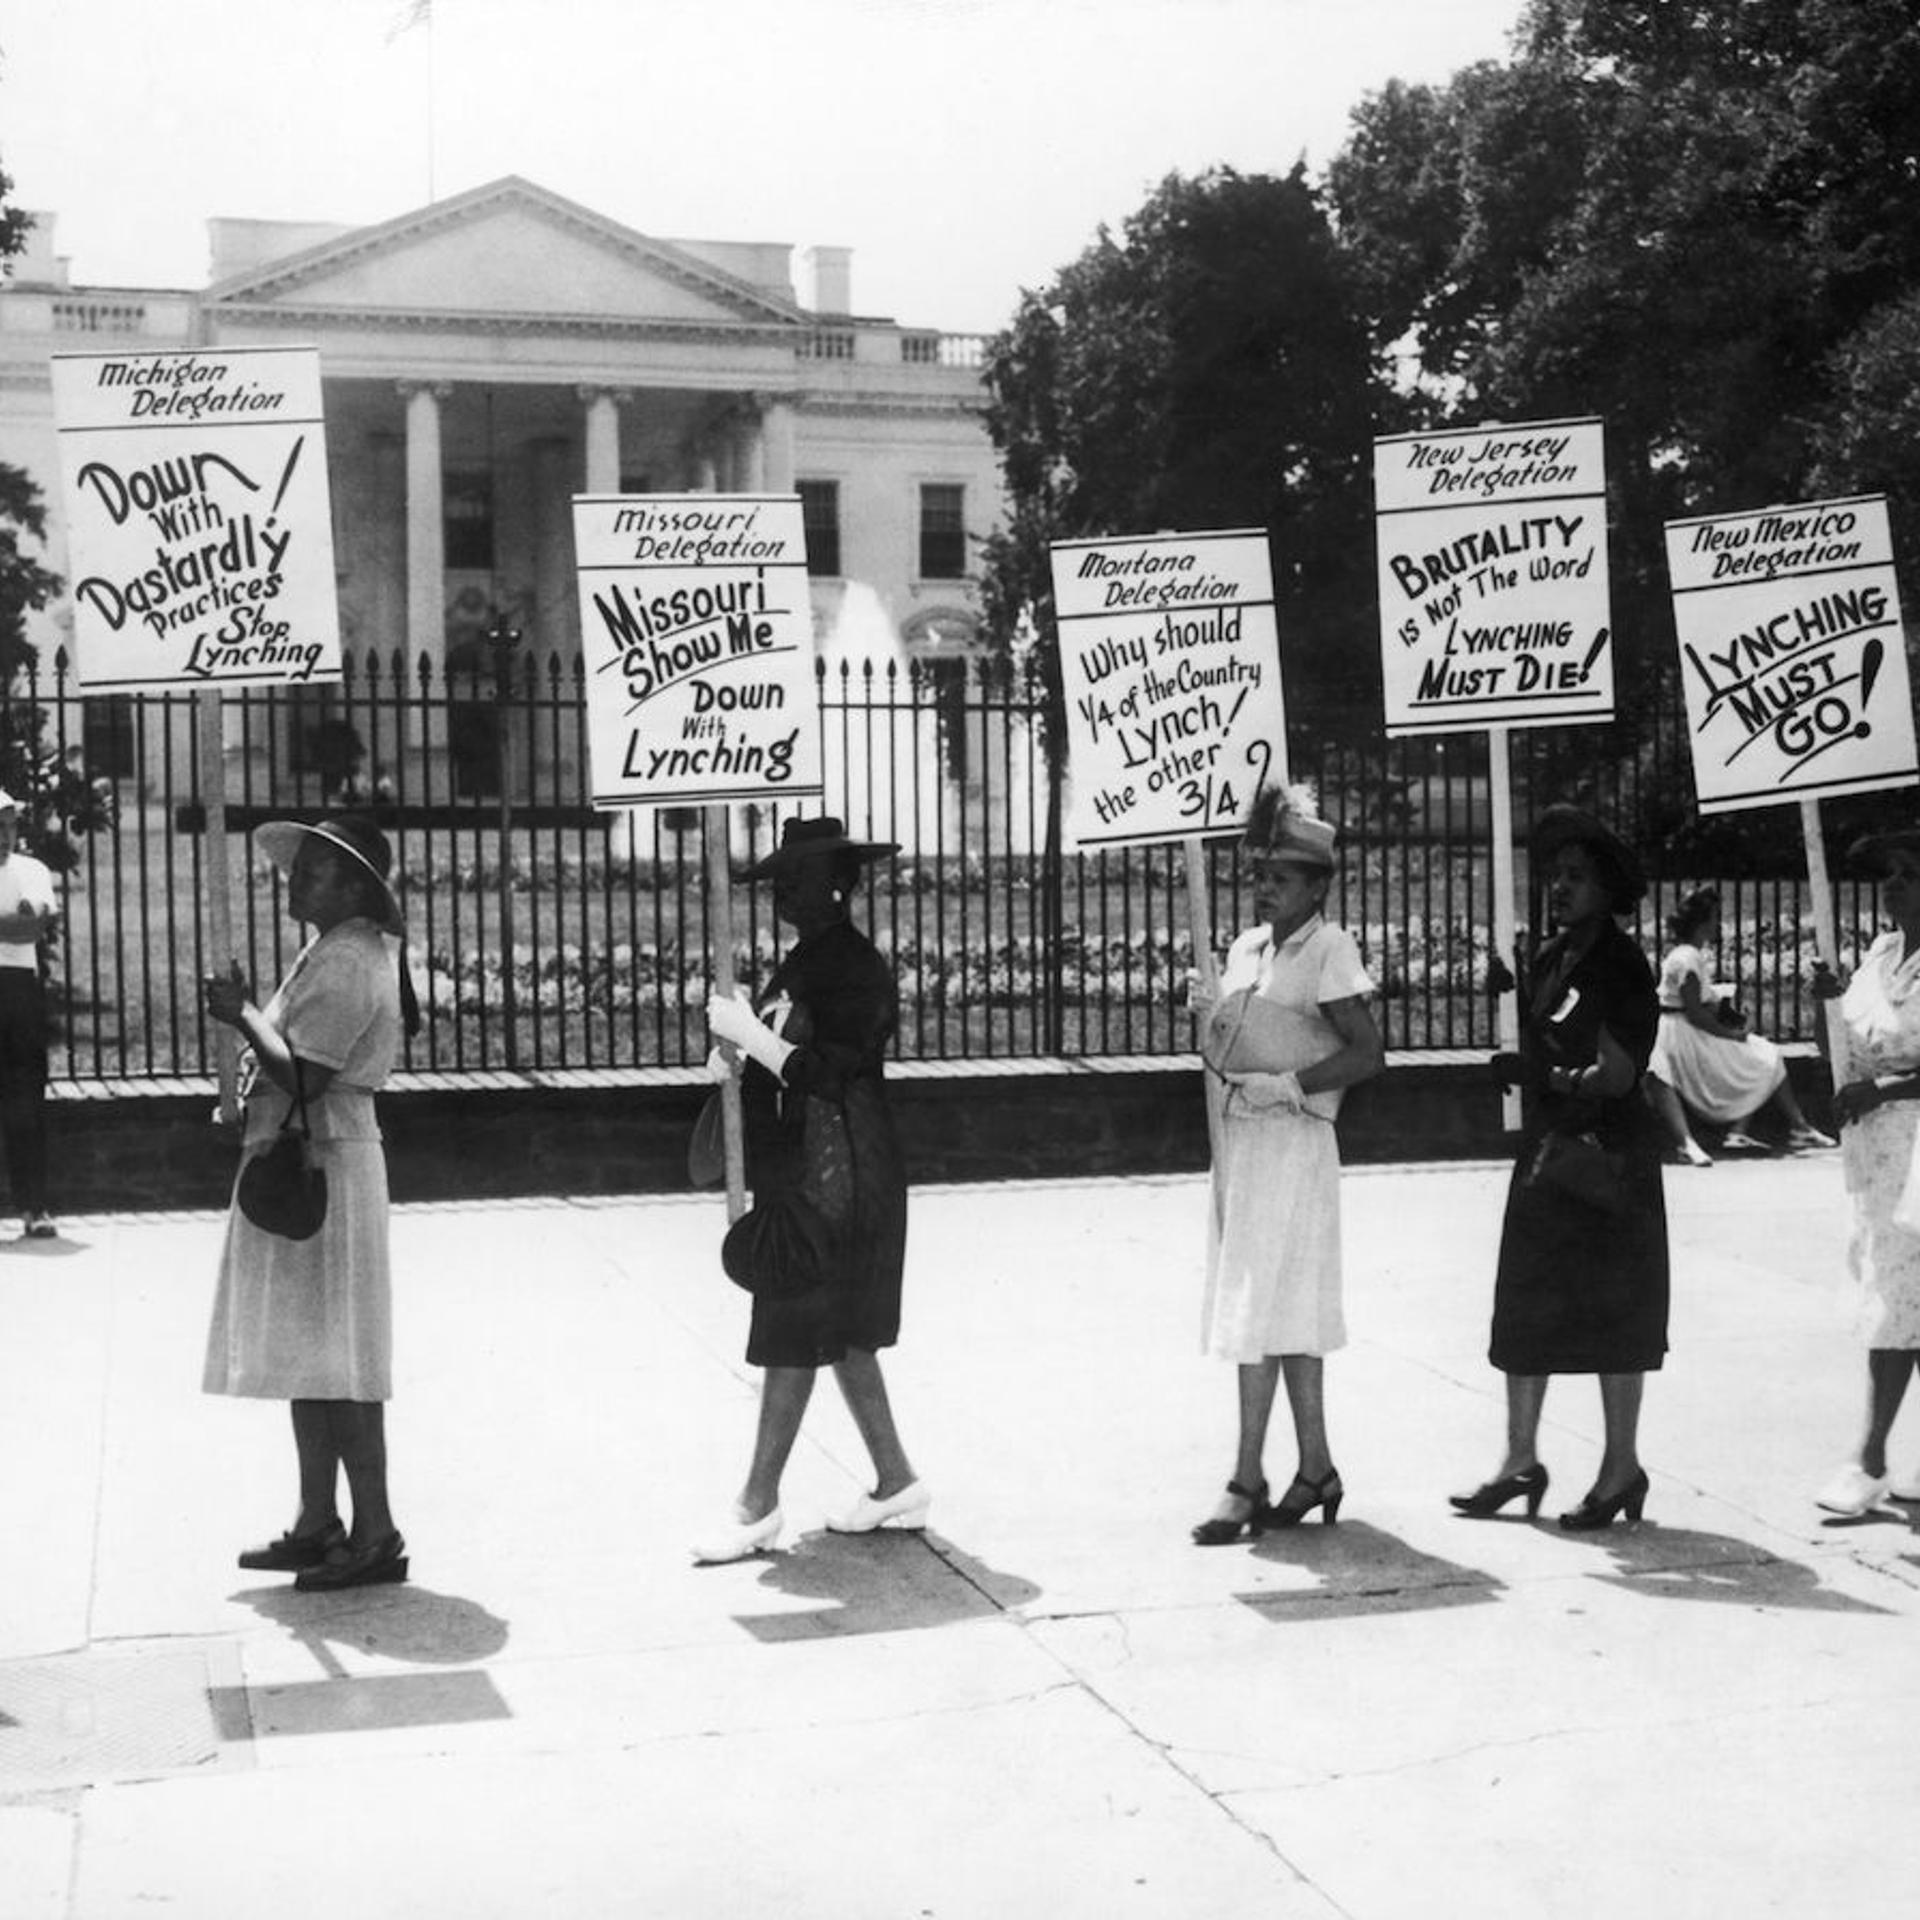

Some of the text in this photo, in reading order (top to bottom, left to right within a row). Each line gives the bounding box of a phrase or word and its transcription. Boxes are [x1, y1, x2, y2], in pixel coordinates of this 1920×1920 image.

[98, 358, 227, 387] Michigan
[130, 382, 284, 420] Delegation
[1407, 435, 1571, 468] New Jersey
[1429, 460, 1577, 497] Delegation
[149, 496, 223, 543] With
[614, 504, 760, 533] Missouri
[1692, 506, 1856, 553] New Mexico
[634, 532, 786, 566] Delegation
[1077, 550, 1196, 579] Montana
[1389, 515, 1584, 600] BRUTALITY
[1713, 539, 1862, 580] Delegation
[592, 565, 766, 651] Missouri
[1103, 575, 1240, 608] Delegation
[1424, 582, 1463, 626] Not
[1467, 566, 1519, 598] The
[1529, 546, 1595, 582] Word
[216, 603, 290, 645] Stop
[1079, 606, 1242, 684] Why should
[1445, 617, 1575, 656] LYNCHING
[181, 633, 324, 681] Lynching
[622, 613, 774, 701] Show Me
[1416, 627, 1609, 701] MUST DIE!
[1684, 586, 1889, 714] LYNCHING
[689, 680, 785, 713] Down
[1078, 655, 1262, 744] 1/4 of the Country
[1729, 652, 1836, 735] MUST
[682, 715, 727, 741] With
[1115, 686, 1249, 770] Lynch!
[621, 727, 800, 783] Lynching
[1093, 743, 1223, 825] the other
